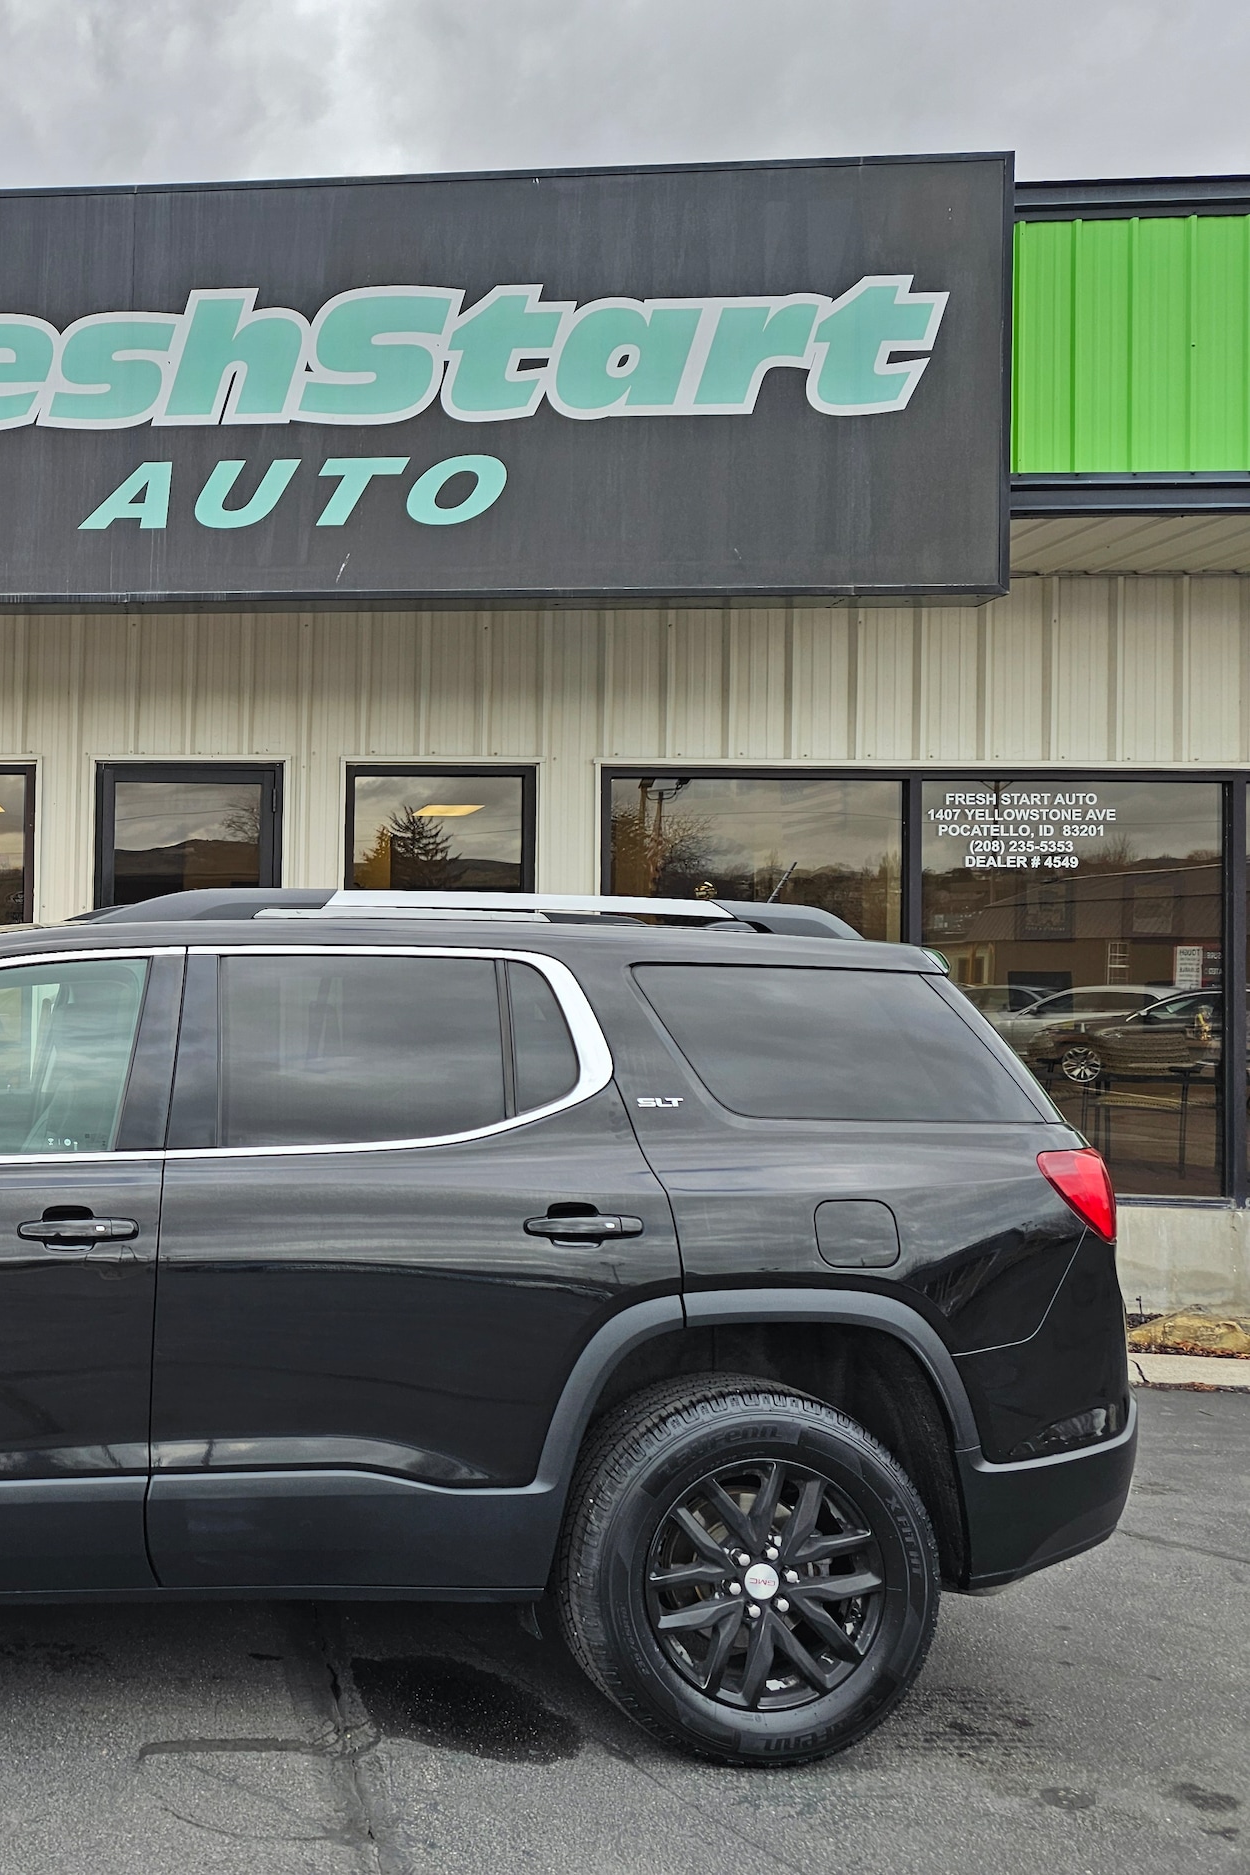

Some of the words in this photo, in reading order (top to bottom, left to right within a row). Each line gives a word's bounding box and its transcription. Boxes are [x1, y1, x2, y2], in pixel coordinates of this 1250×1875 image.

[78, 454, 508, 530] AUTO
[946, 793, 996, 805] FRESH
[1001, 793, 1051, 805] START
[1054, 793, 1097, 805] AUTO
[927, 809, 961, 821] 1407
[965, 809, 1082, 821] YELLOWSTONE
[1086, 809, 1116, 821] AVE
[938, 825, 1035, 838] POCATELLO,
[1039, 825, 1054, 836] ID
[1062, 825, 1104, 836] 83201
[969, 840, 1005, 854] (208)
[1009, 841, 1073, 852] 235-5353
[965, 856, 1027, 868] DEALER
[1031, 856, 1040, 868] #
[1044, 856, 1079, 868] 4549
[637, 1097, 684, 1107] SLT
[749, 1577, 776, 1586] GMC
